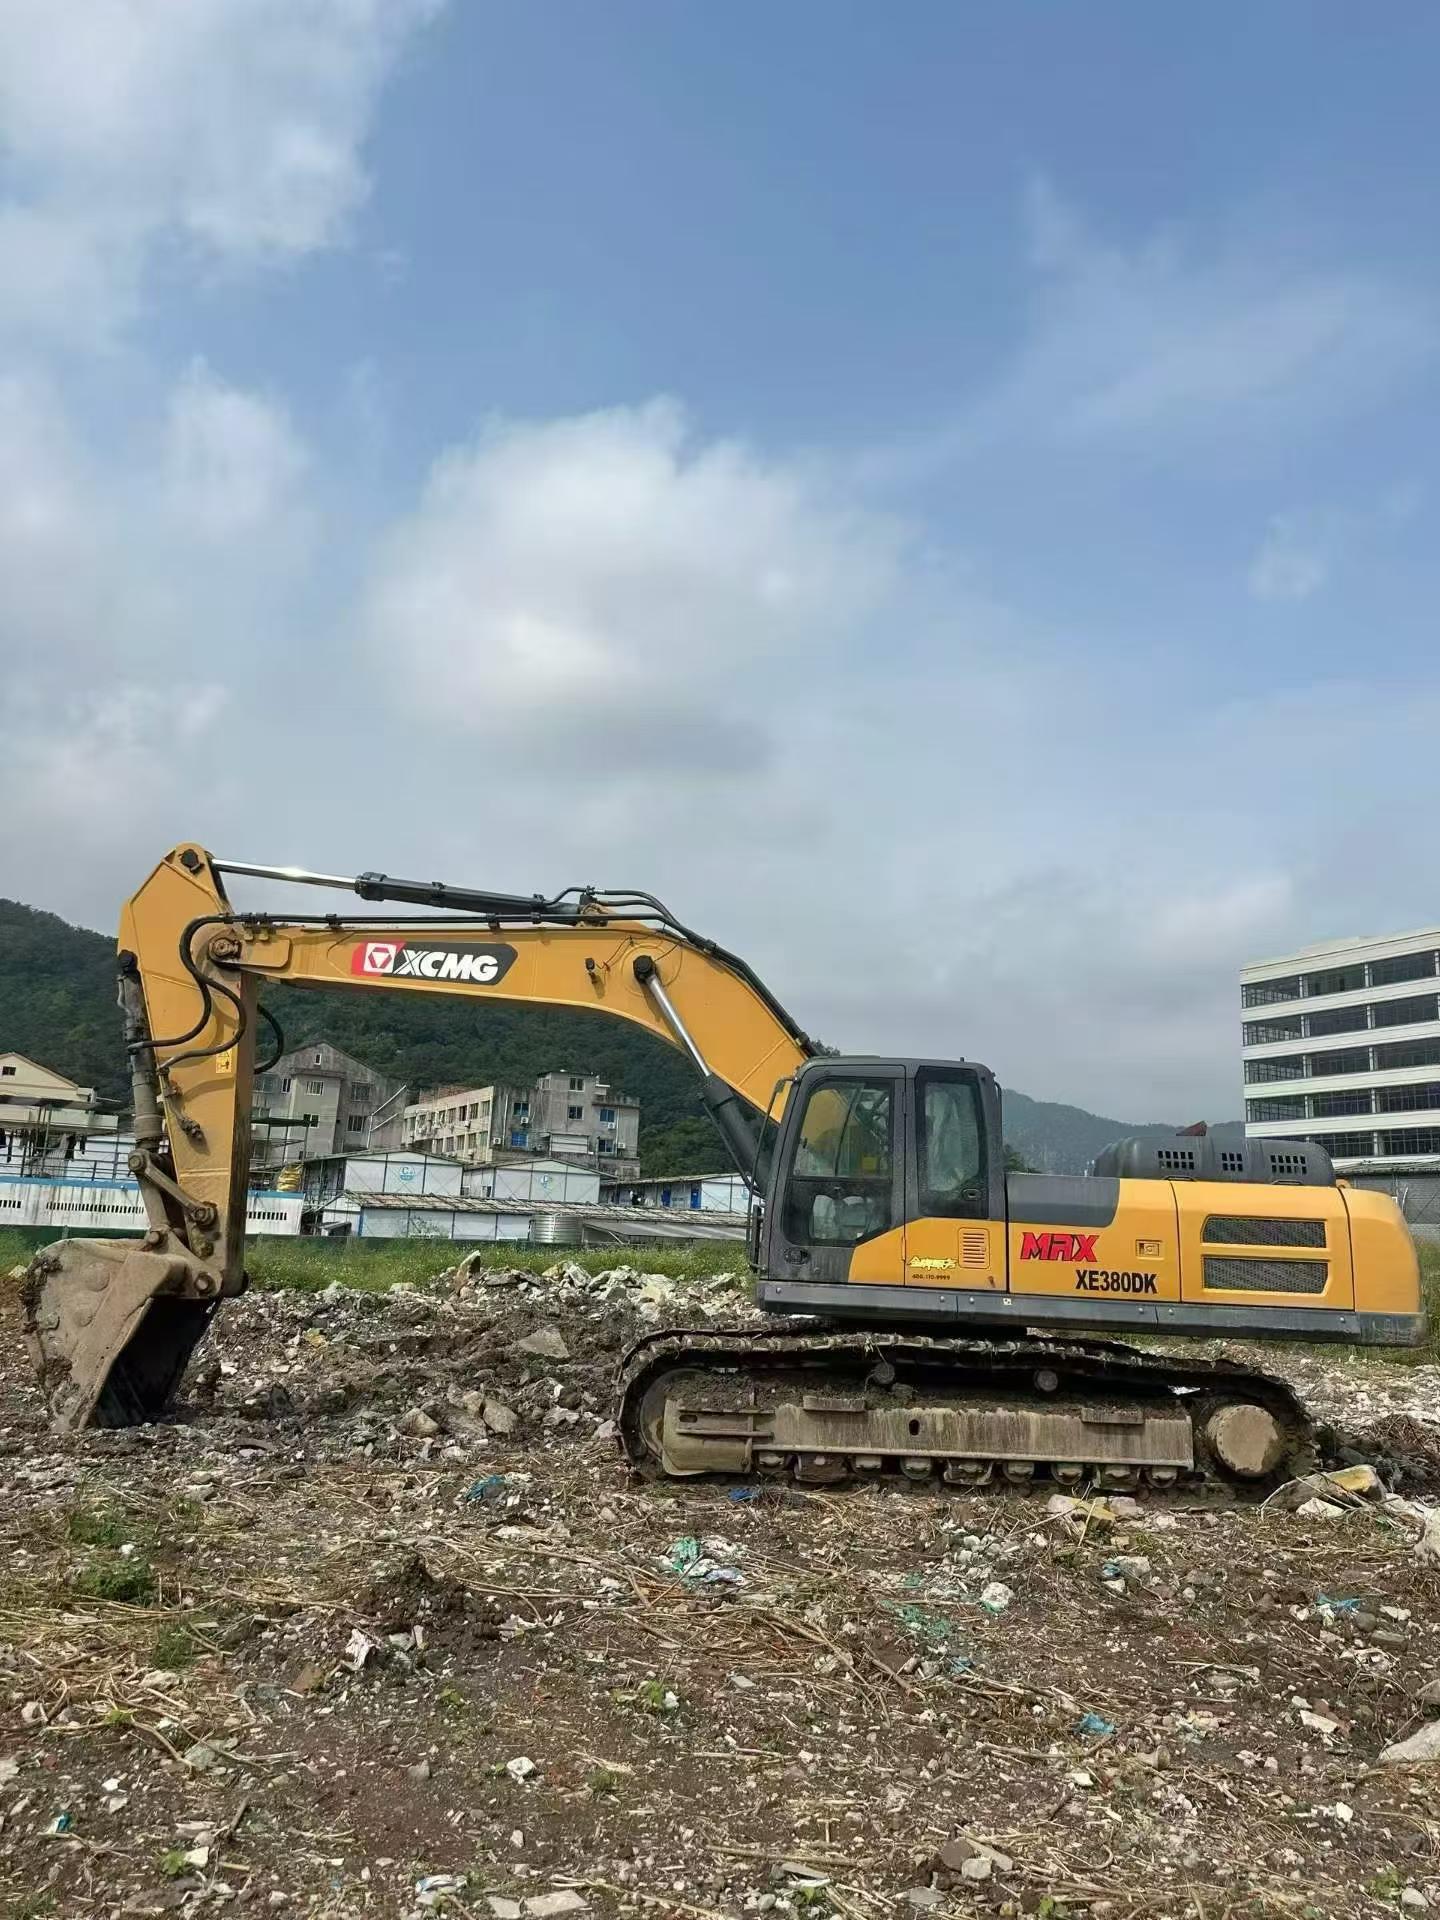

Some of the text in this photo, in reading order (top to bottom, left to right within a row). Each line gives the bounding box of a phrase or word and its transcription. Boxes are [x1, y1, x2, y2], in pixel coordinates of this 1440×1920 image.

[393, 949, 498, 981] XCMG
[1020, 1232, 1099, 1262] MAX
[1075, 1269, 1158, 1294] XE380DK
